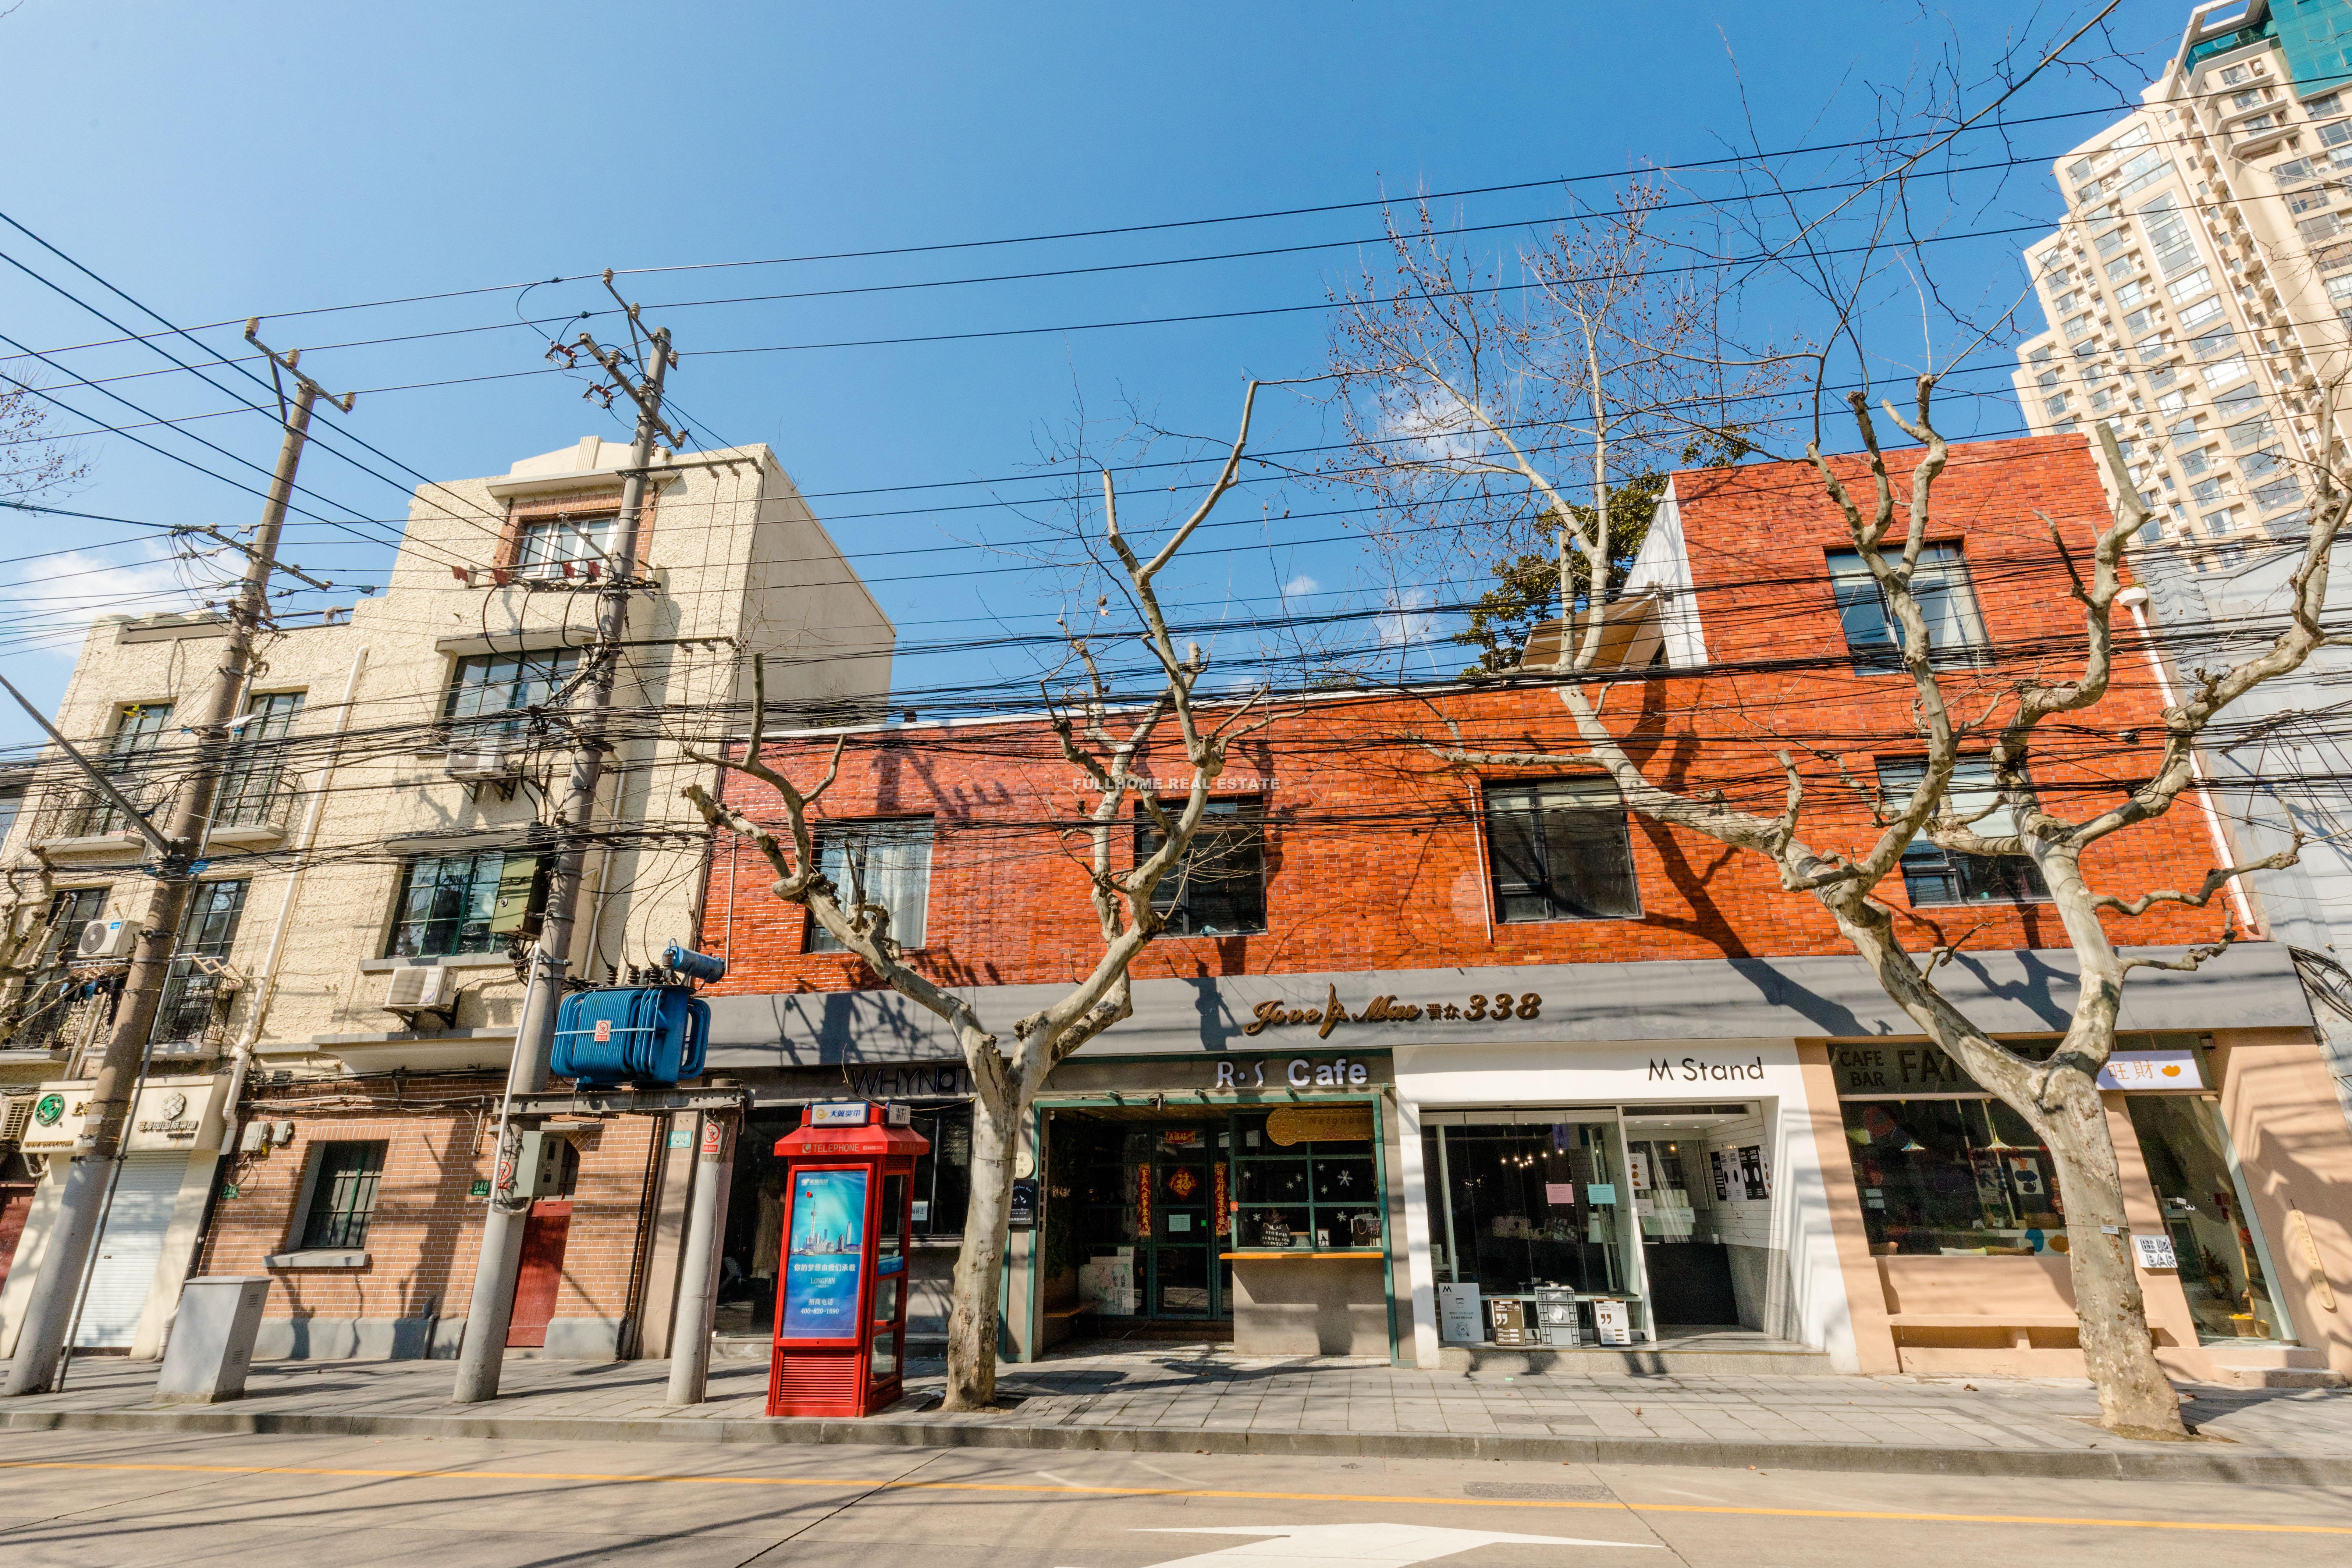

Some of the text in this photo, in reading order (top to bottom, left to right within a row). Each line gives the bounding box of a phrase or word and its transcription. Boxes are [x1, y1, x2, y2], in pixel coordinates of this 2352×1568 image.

[1426, 1003, 1461, 1020] 晋众
[1464, 993, 1541, 1021] 338
[1244, 999, 1322, 1034] Jove
[1840, 1050, 1884, 1067] CAFE
[1288, 1059, 1367, 1087] Cafe
[1649, 1056, 1764, 1081] M Stand
[2106, 1060, 2153, 1080] 旺財
[1851, 1071, 1886, 1087] BAR
[829, 1109, 862, 1117] 天翼宽带
[137, 1121, 199, 1131] 福寿园国际集团
[1309, 1116, 1370, 1128] Neighbor
[813, 1144, 859, 1153] TELEPHONE
[474, 1182, 488, 1191] 340
[2140, 1238, 2171, 1252] 旺财
[794, 1263, 856, 1272] 你的梦想由我们承载
[2146, 1254, 2177, 1266] BAR
